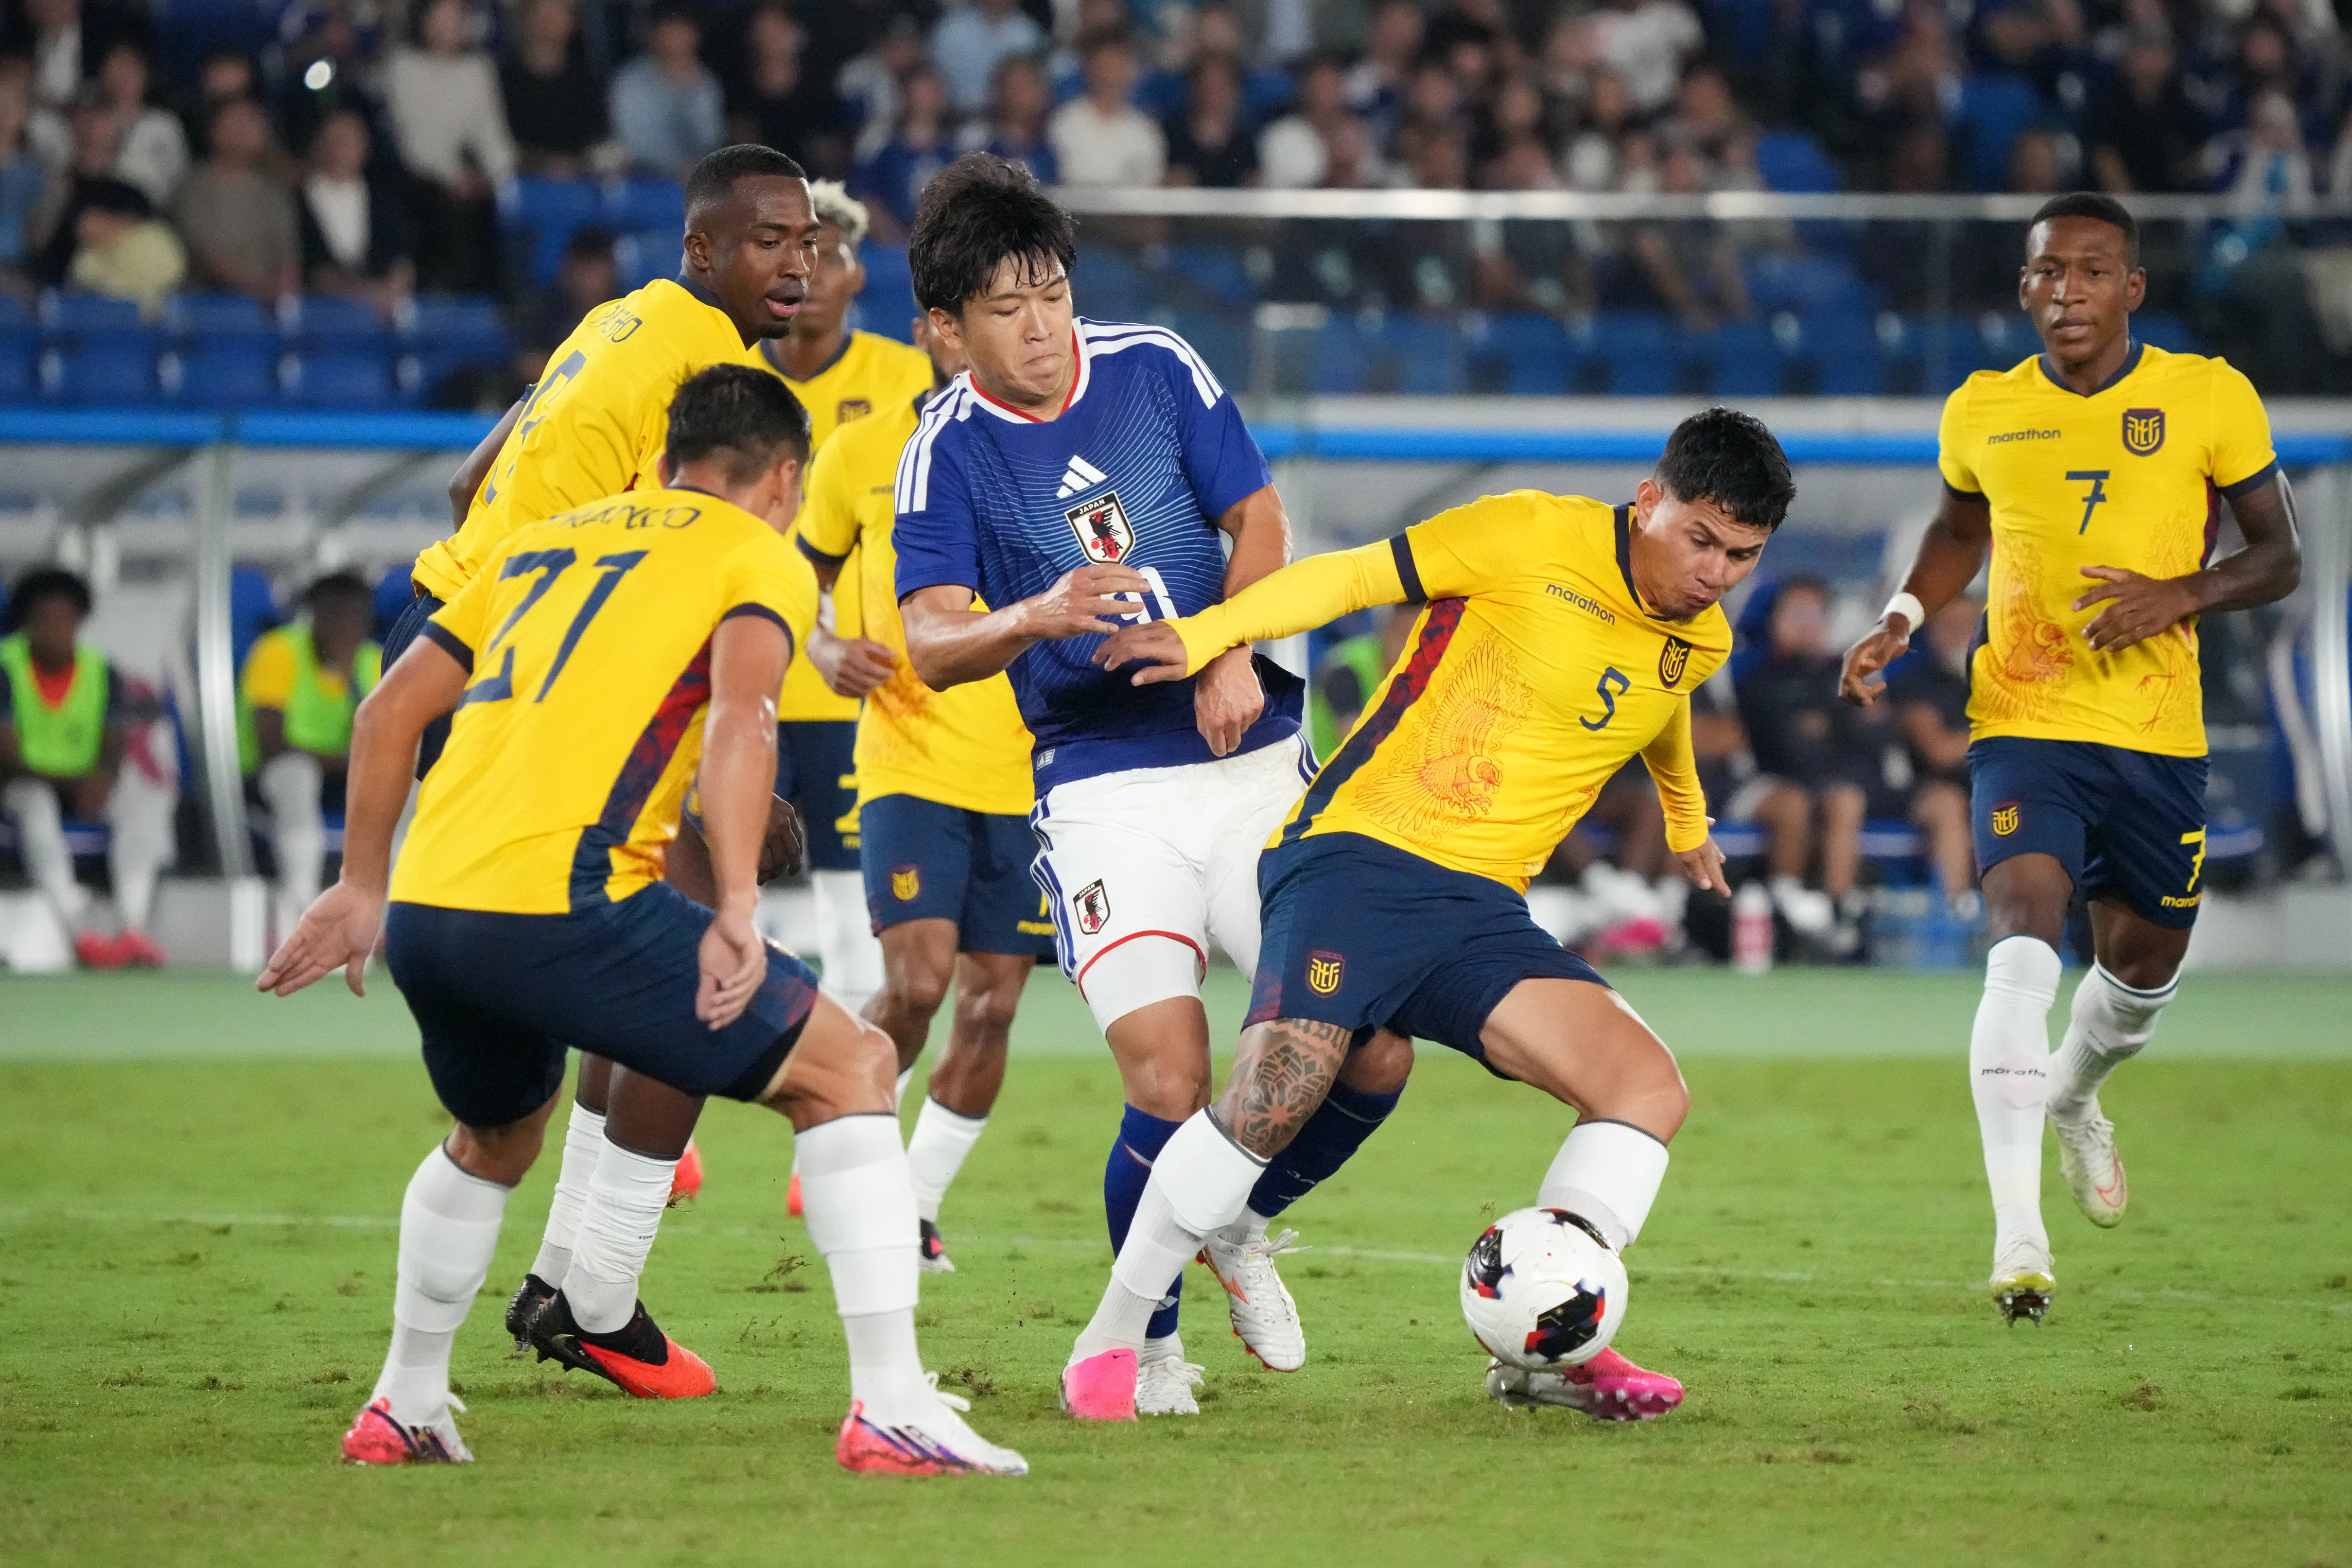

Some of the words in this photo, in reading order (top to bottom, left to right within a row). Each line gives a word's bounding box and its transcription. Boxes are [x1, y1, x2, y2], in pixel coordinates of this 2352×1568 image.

[1987, 429, 2061, 444] marathon
[1079, 499, 1105, 514] JAPAN
[2066, 470, 2110, 535] 7
[454, 547, 650, 713] 21
[1546, 583, 1616, 626] marathon
[1579, 665, 1632, 732] 5
[2180, 824, 2207, 892] 7
[1079, 883, 1096, 898] JAPAN
